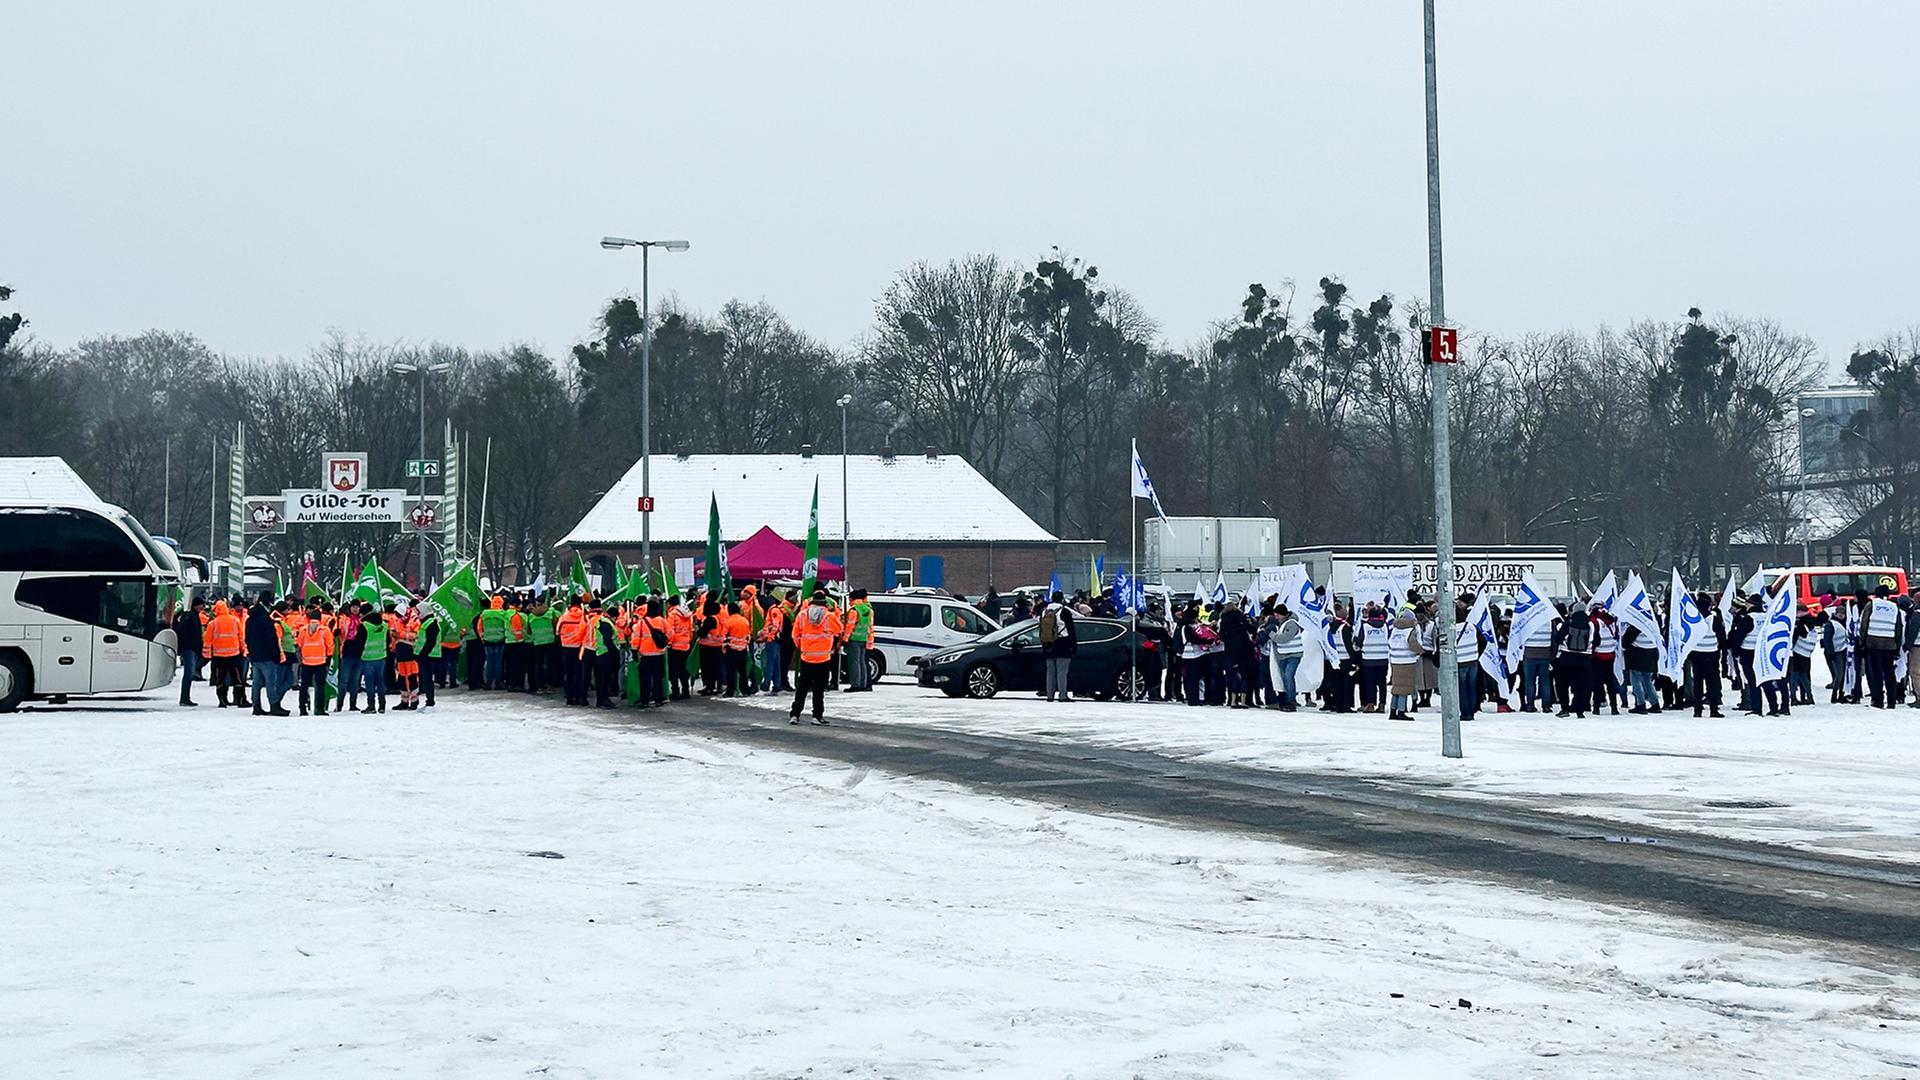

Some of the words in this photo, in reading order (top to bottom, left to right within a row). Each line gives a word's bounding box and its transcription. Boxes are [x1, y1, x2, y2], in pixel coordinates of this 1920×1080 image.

[300, 494, 390, 508] Gilde-Tor
[643, 497, 650, 511] 6
[297, 512, 316, 521] Auf
[319, 512, 392, 521] Wiedersehen
[761, 568, 799, 577] www.dbb.de
[1425, 564, 1465, 582] UD
